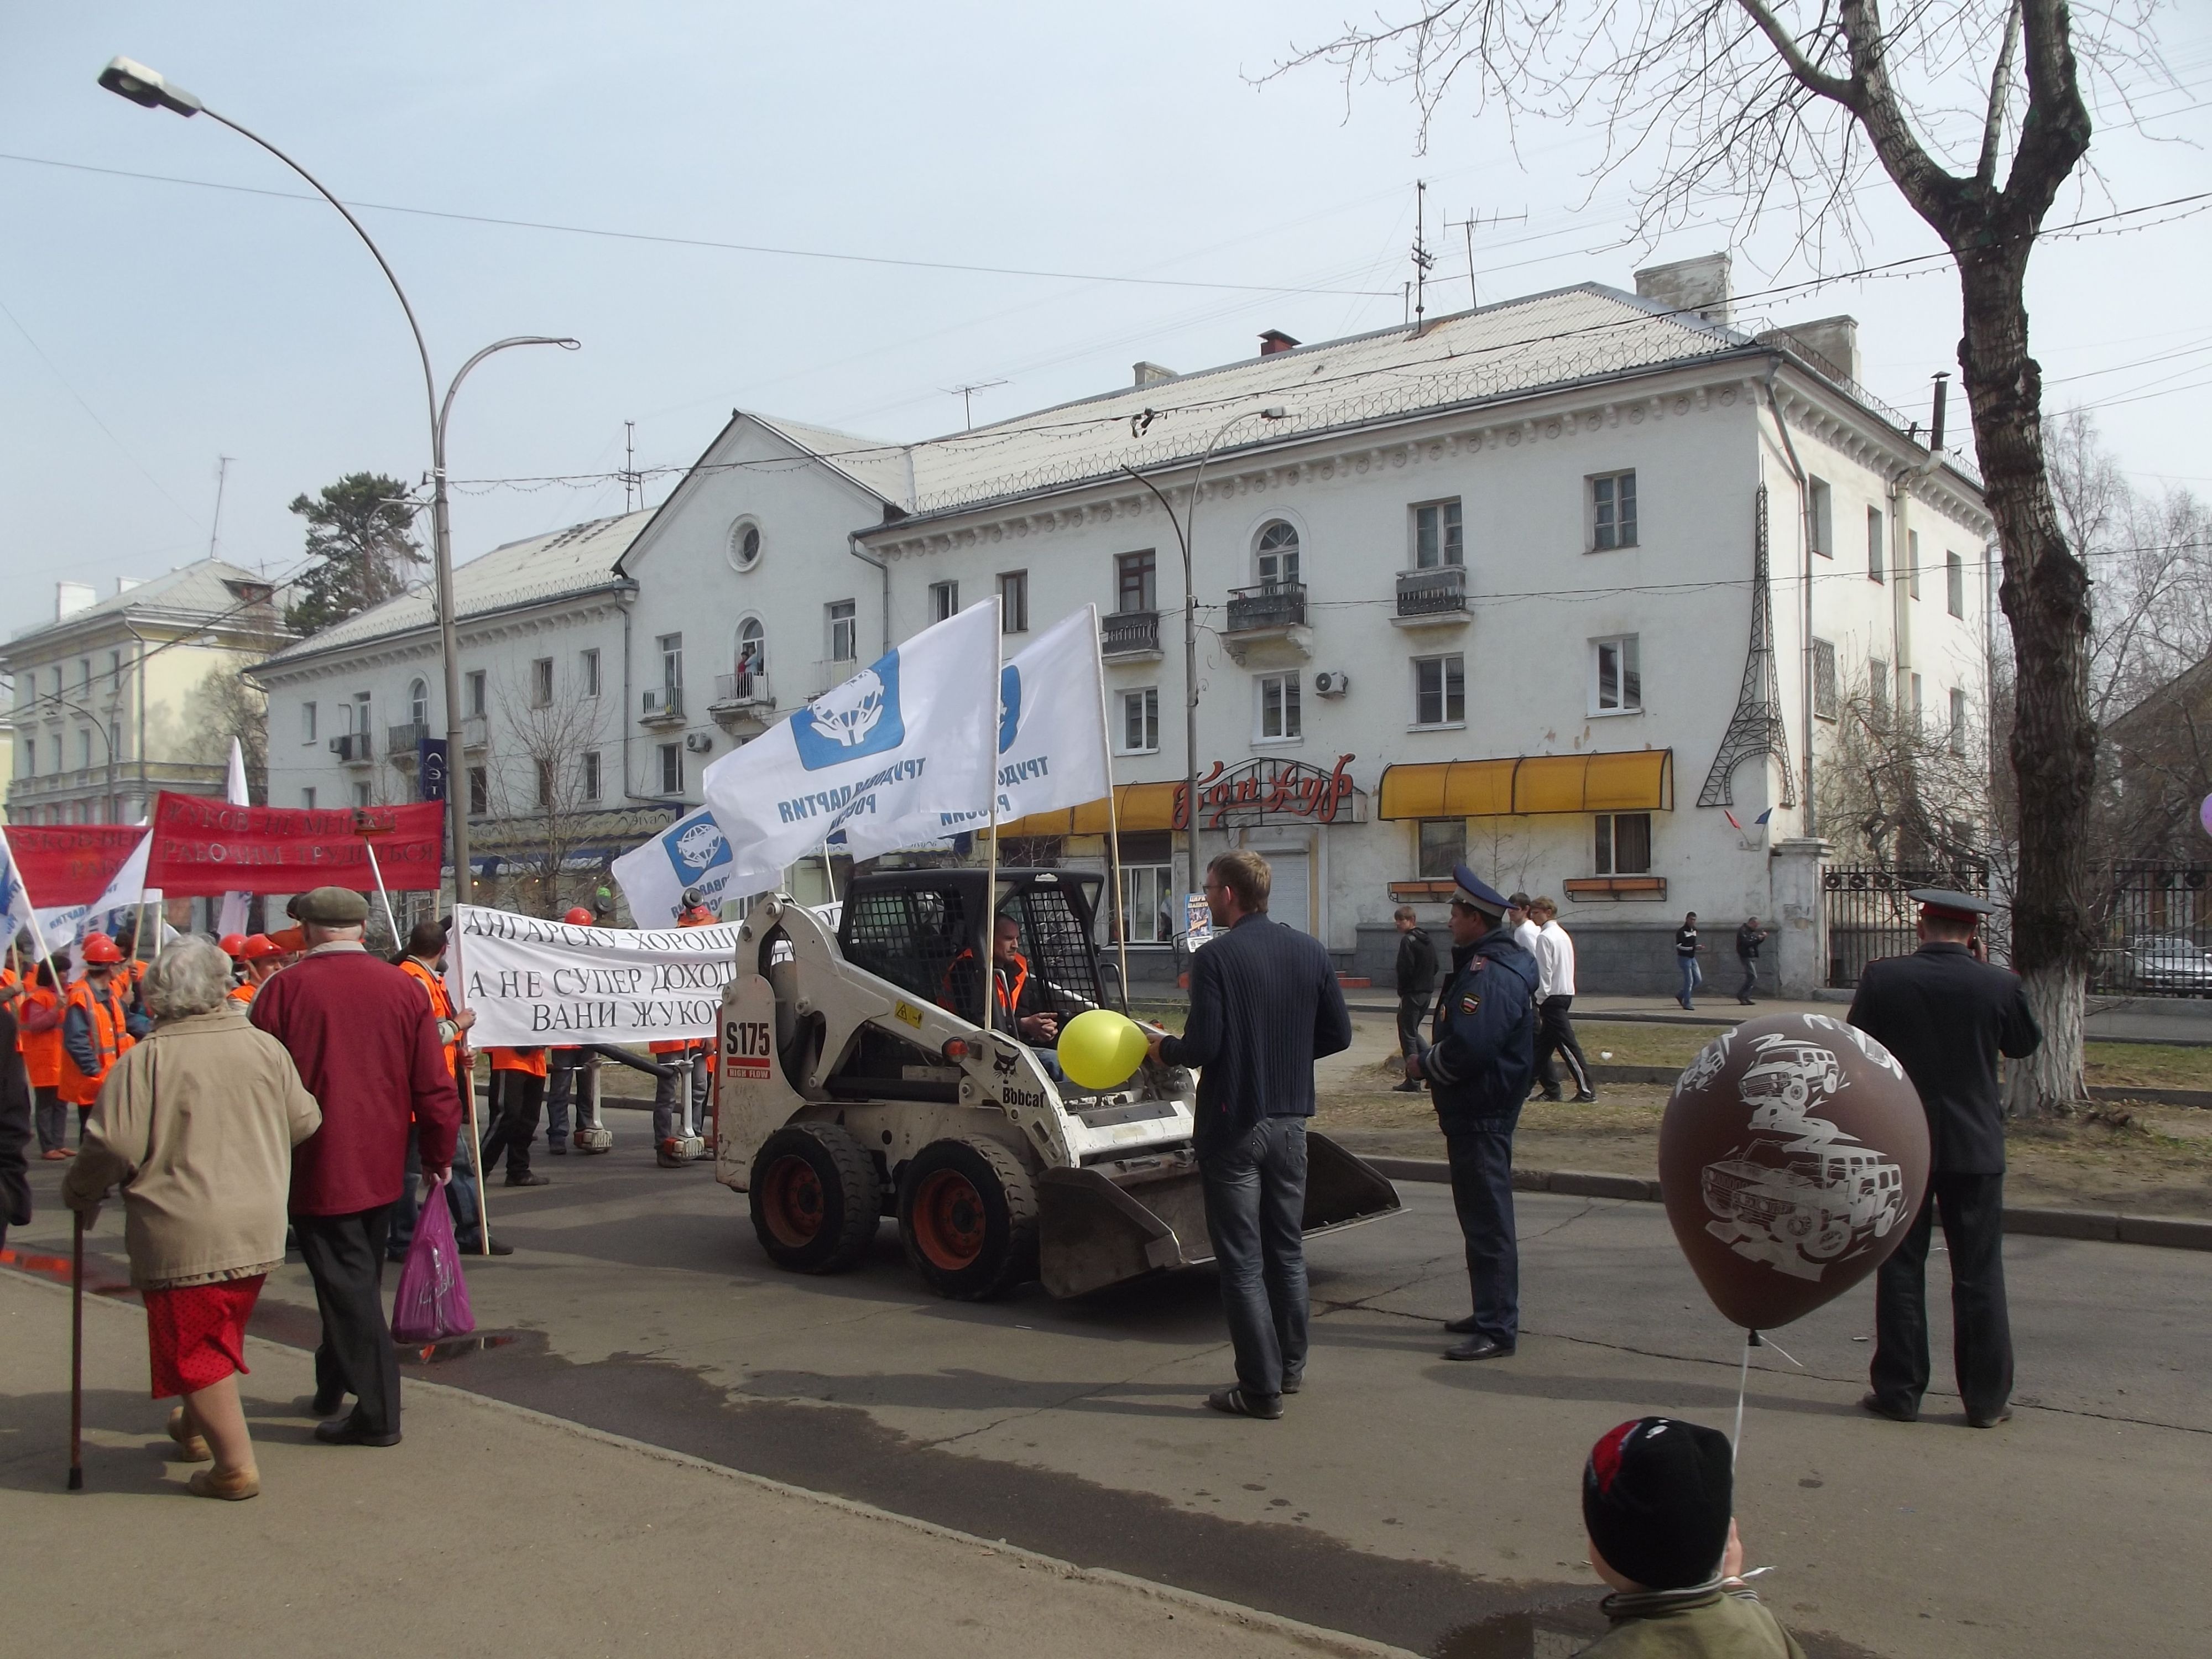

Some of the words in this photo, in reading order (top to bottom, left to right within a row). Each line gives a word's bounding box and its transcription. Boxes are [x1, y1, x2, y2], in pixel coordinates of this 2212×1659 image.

[160, 803, 248, 832] ЖУКОВ
[163, 840, 283, 865] РАБОЧИМ
[463, 910, 615, 948] АНГАРСКУ
[467, 969, 488, 998] А
[498, 971, 544, 998] НЕ
[554, 968, 641, 995] СУПЕР
[651, 960, 737, 995] ДОХОД
[531, 1001, 617, 1031] ВАНИ
[726, 1022, 770, 1056] S175
[1003, 1087, 1045, 1108] Bobcat
